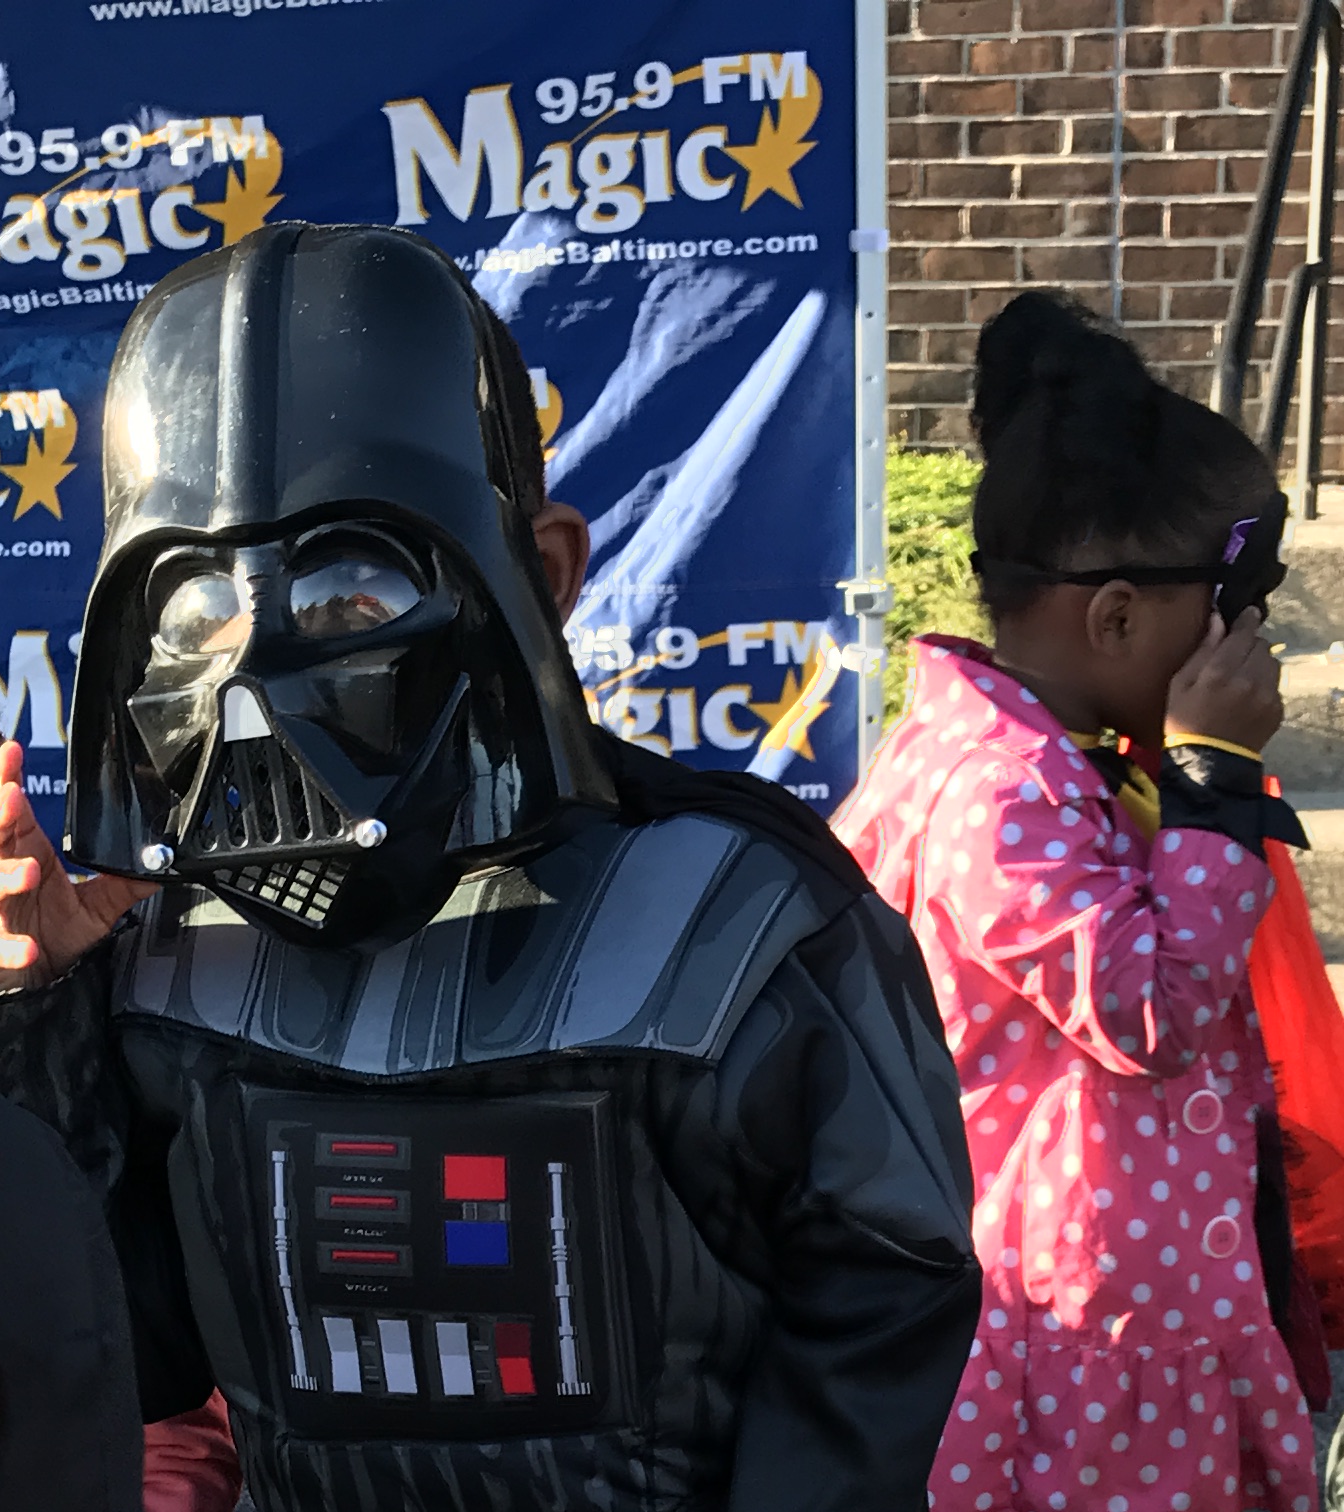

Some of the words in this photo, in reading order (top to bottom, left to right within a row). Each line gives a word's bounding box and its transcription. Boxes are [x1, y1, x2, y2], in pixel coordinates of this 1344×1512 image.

[535, 61, 674, 124] 95.9
[702, 51, 808, 105] FM
[166, 115, 268, 167] FM
[380, 82, 738, 235] Magic
[727, 620, 824, 667] FM
[584, 682, 761, 758] gic
